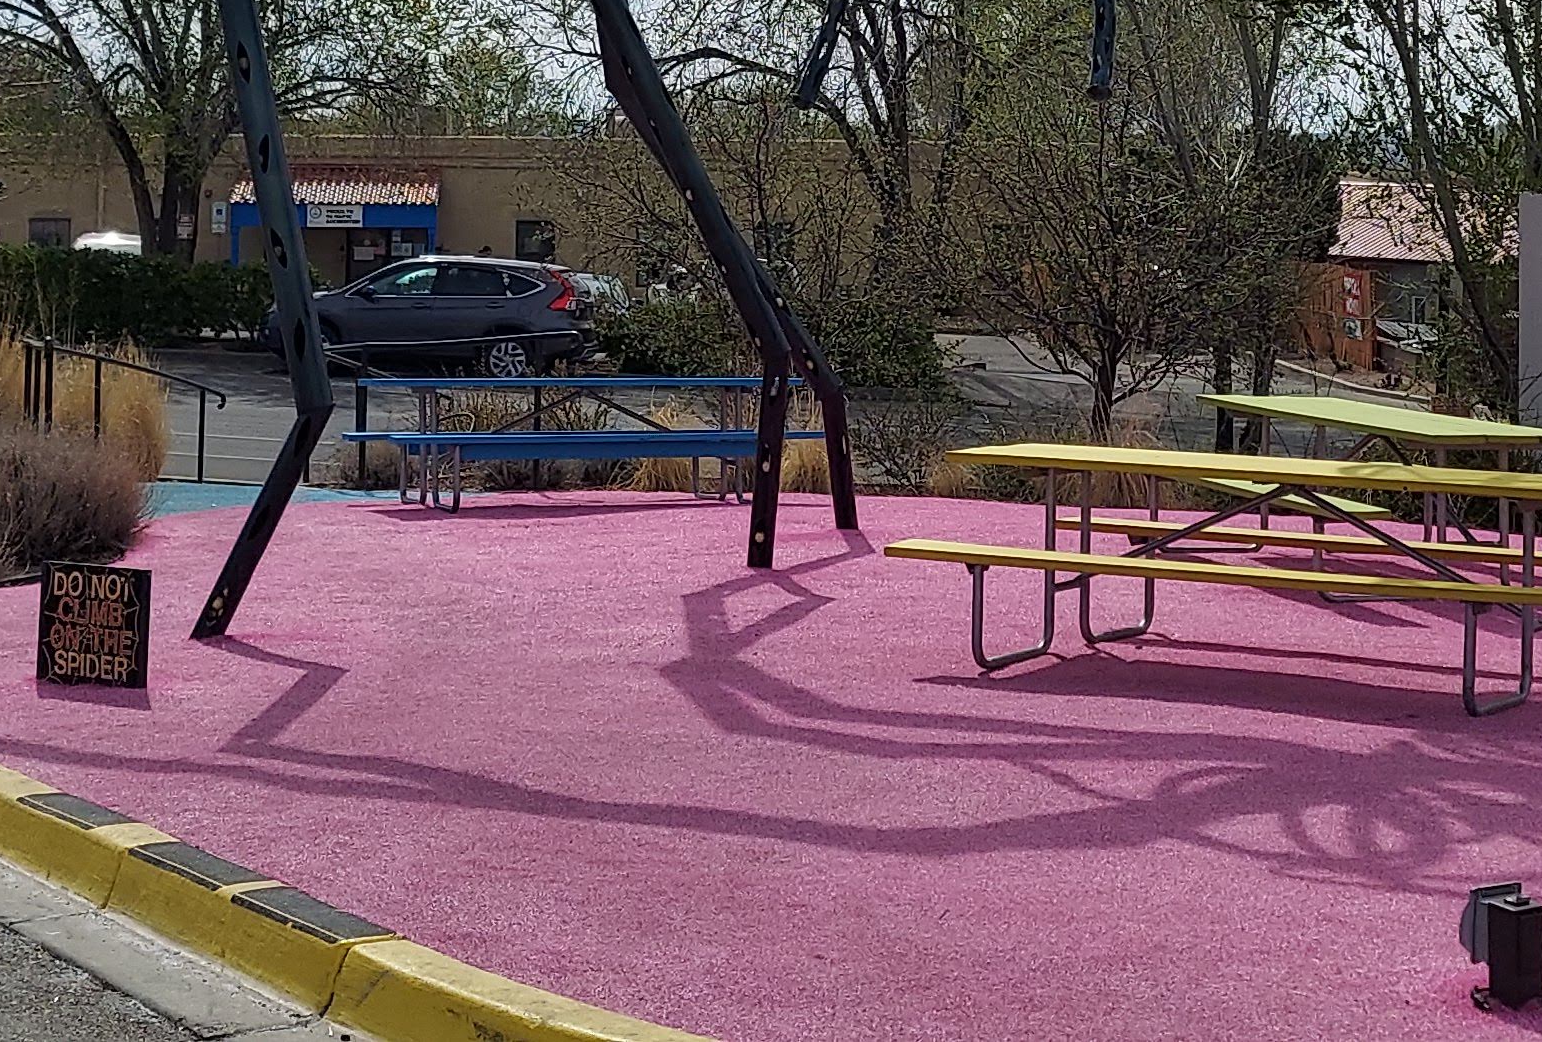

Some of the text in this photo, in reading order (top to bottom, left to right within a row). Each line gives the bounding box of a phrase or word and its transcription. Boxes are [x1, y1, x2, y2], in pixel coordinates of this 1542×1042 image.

[54, 571, 130, 602] DO NOT
[58, 596, 124, 627] CLIMB
[50, 623, 134, 656] ON THE
[54, 650, 128, 682] SPIDER
